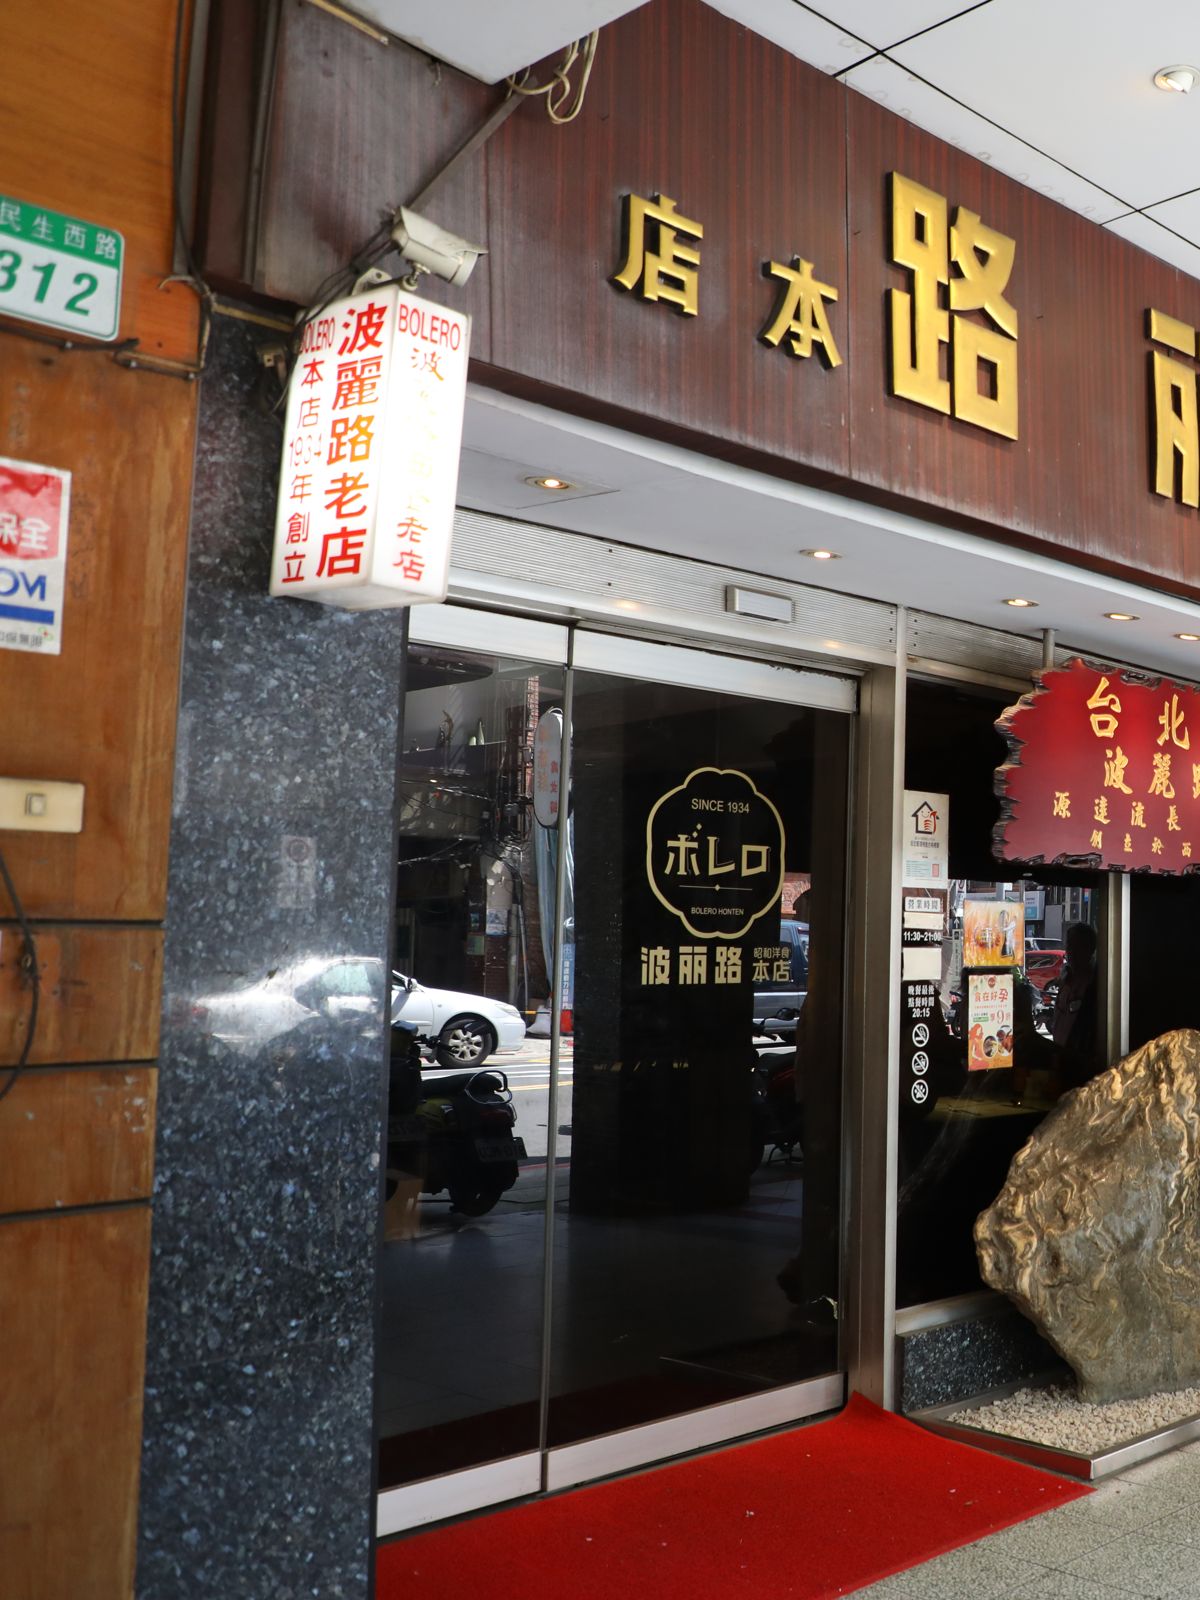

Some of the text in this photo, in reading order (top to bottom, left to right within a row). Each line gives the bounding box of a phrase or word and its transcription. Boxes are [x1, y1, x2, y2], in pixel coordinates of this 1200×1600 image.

[0, 202, 116, 260] 民生西路
[0, 249, 98, 316] 312
[399, 304, 461, 351] BOLERO
[316, 303, 388, 578] 波麗路老店
[691, 798, 750, 814] SINCE 1934
[664, 823, 772, 878] ボレロ
[691, 907, 744, 916] BOLERO HONTEN
[908, 899, 939, 910] 營業時間
[641, 946, 792, 986] 波丽路 昭和洋食 本店
[912, 1008, 930, 1018] 20:15
